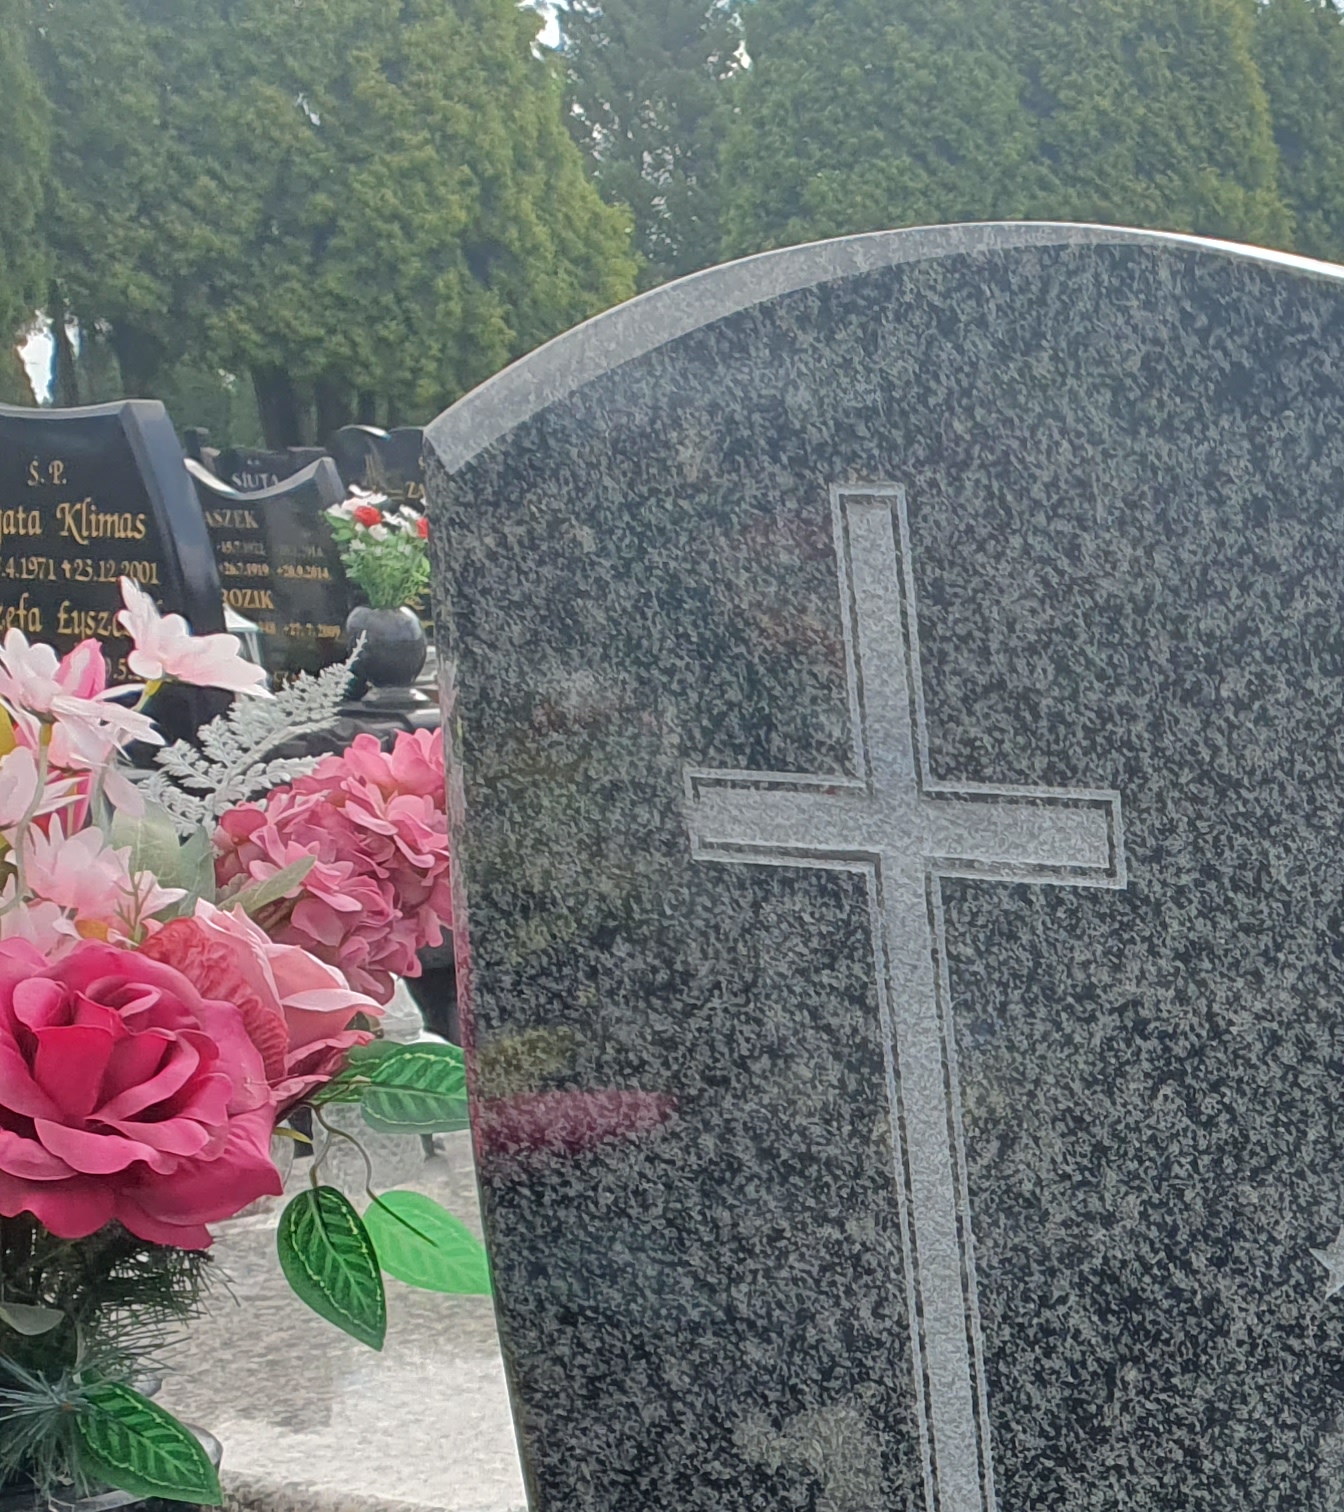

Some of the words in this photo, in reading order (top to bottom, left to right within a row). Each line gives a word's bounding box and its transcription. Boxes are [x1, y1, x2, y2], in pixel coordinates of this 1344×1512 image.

[0, 505, 43, 545] ata
[56, 497, 146, 545] Klimas
[0, 556, 56, 581] .4.1971
